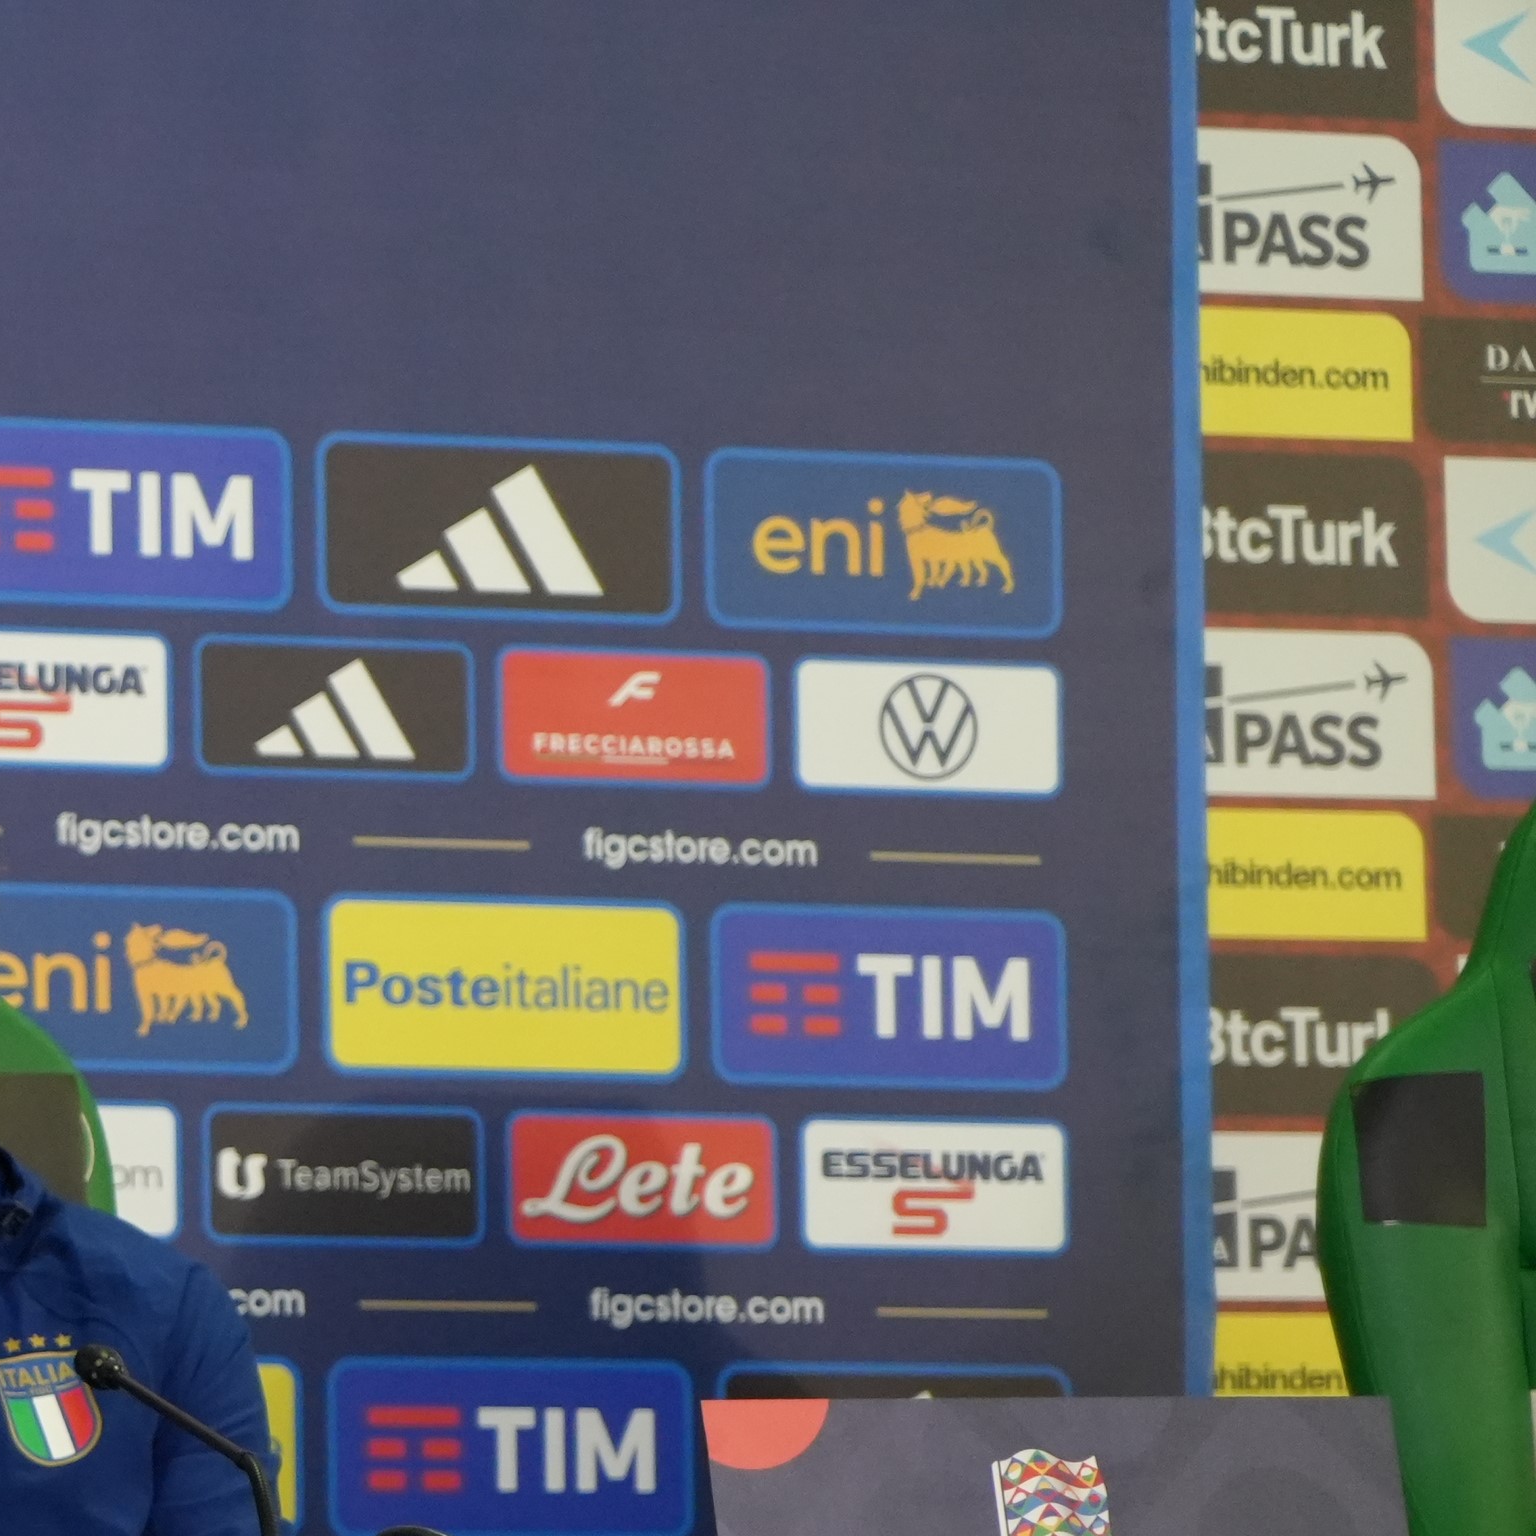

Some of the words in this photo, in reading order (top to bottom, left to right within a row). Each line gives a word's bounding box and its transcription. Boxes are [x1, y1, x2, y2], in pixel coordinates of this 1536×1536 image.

[1195, 4, 1388, 70] tcTurk
[1223, 210, 1370, 270] PASS
[70, 468, 254, 561] TIM
[752, 498, 885, 577] eni
[532, 731, 736, 760] FRECCIAROSSA
[1234, 712, 1383, 769] PASS
[56, 811, 300, 855] figcstore.com
[582, 826, 818, 870] figcstore.com
[343, 960, 669, 1011] Posteitaliane
[856, 953, 1031, 1042] TIM
[275, 1158, 471, 1199] TeamSystem
[522, 1134, 754, 1223] Lete
[821, 1148, 1043, 1184] ESSELUNGA
[590, 1287, 825, 1329] figcstore.com
[476, 1406, 656, 1494] TIM
